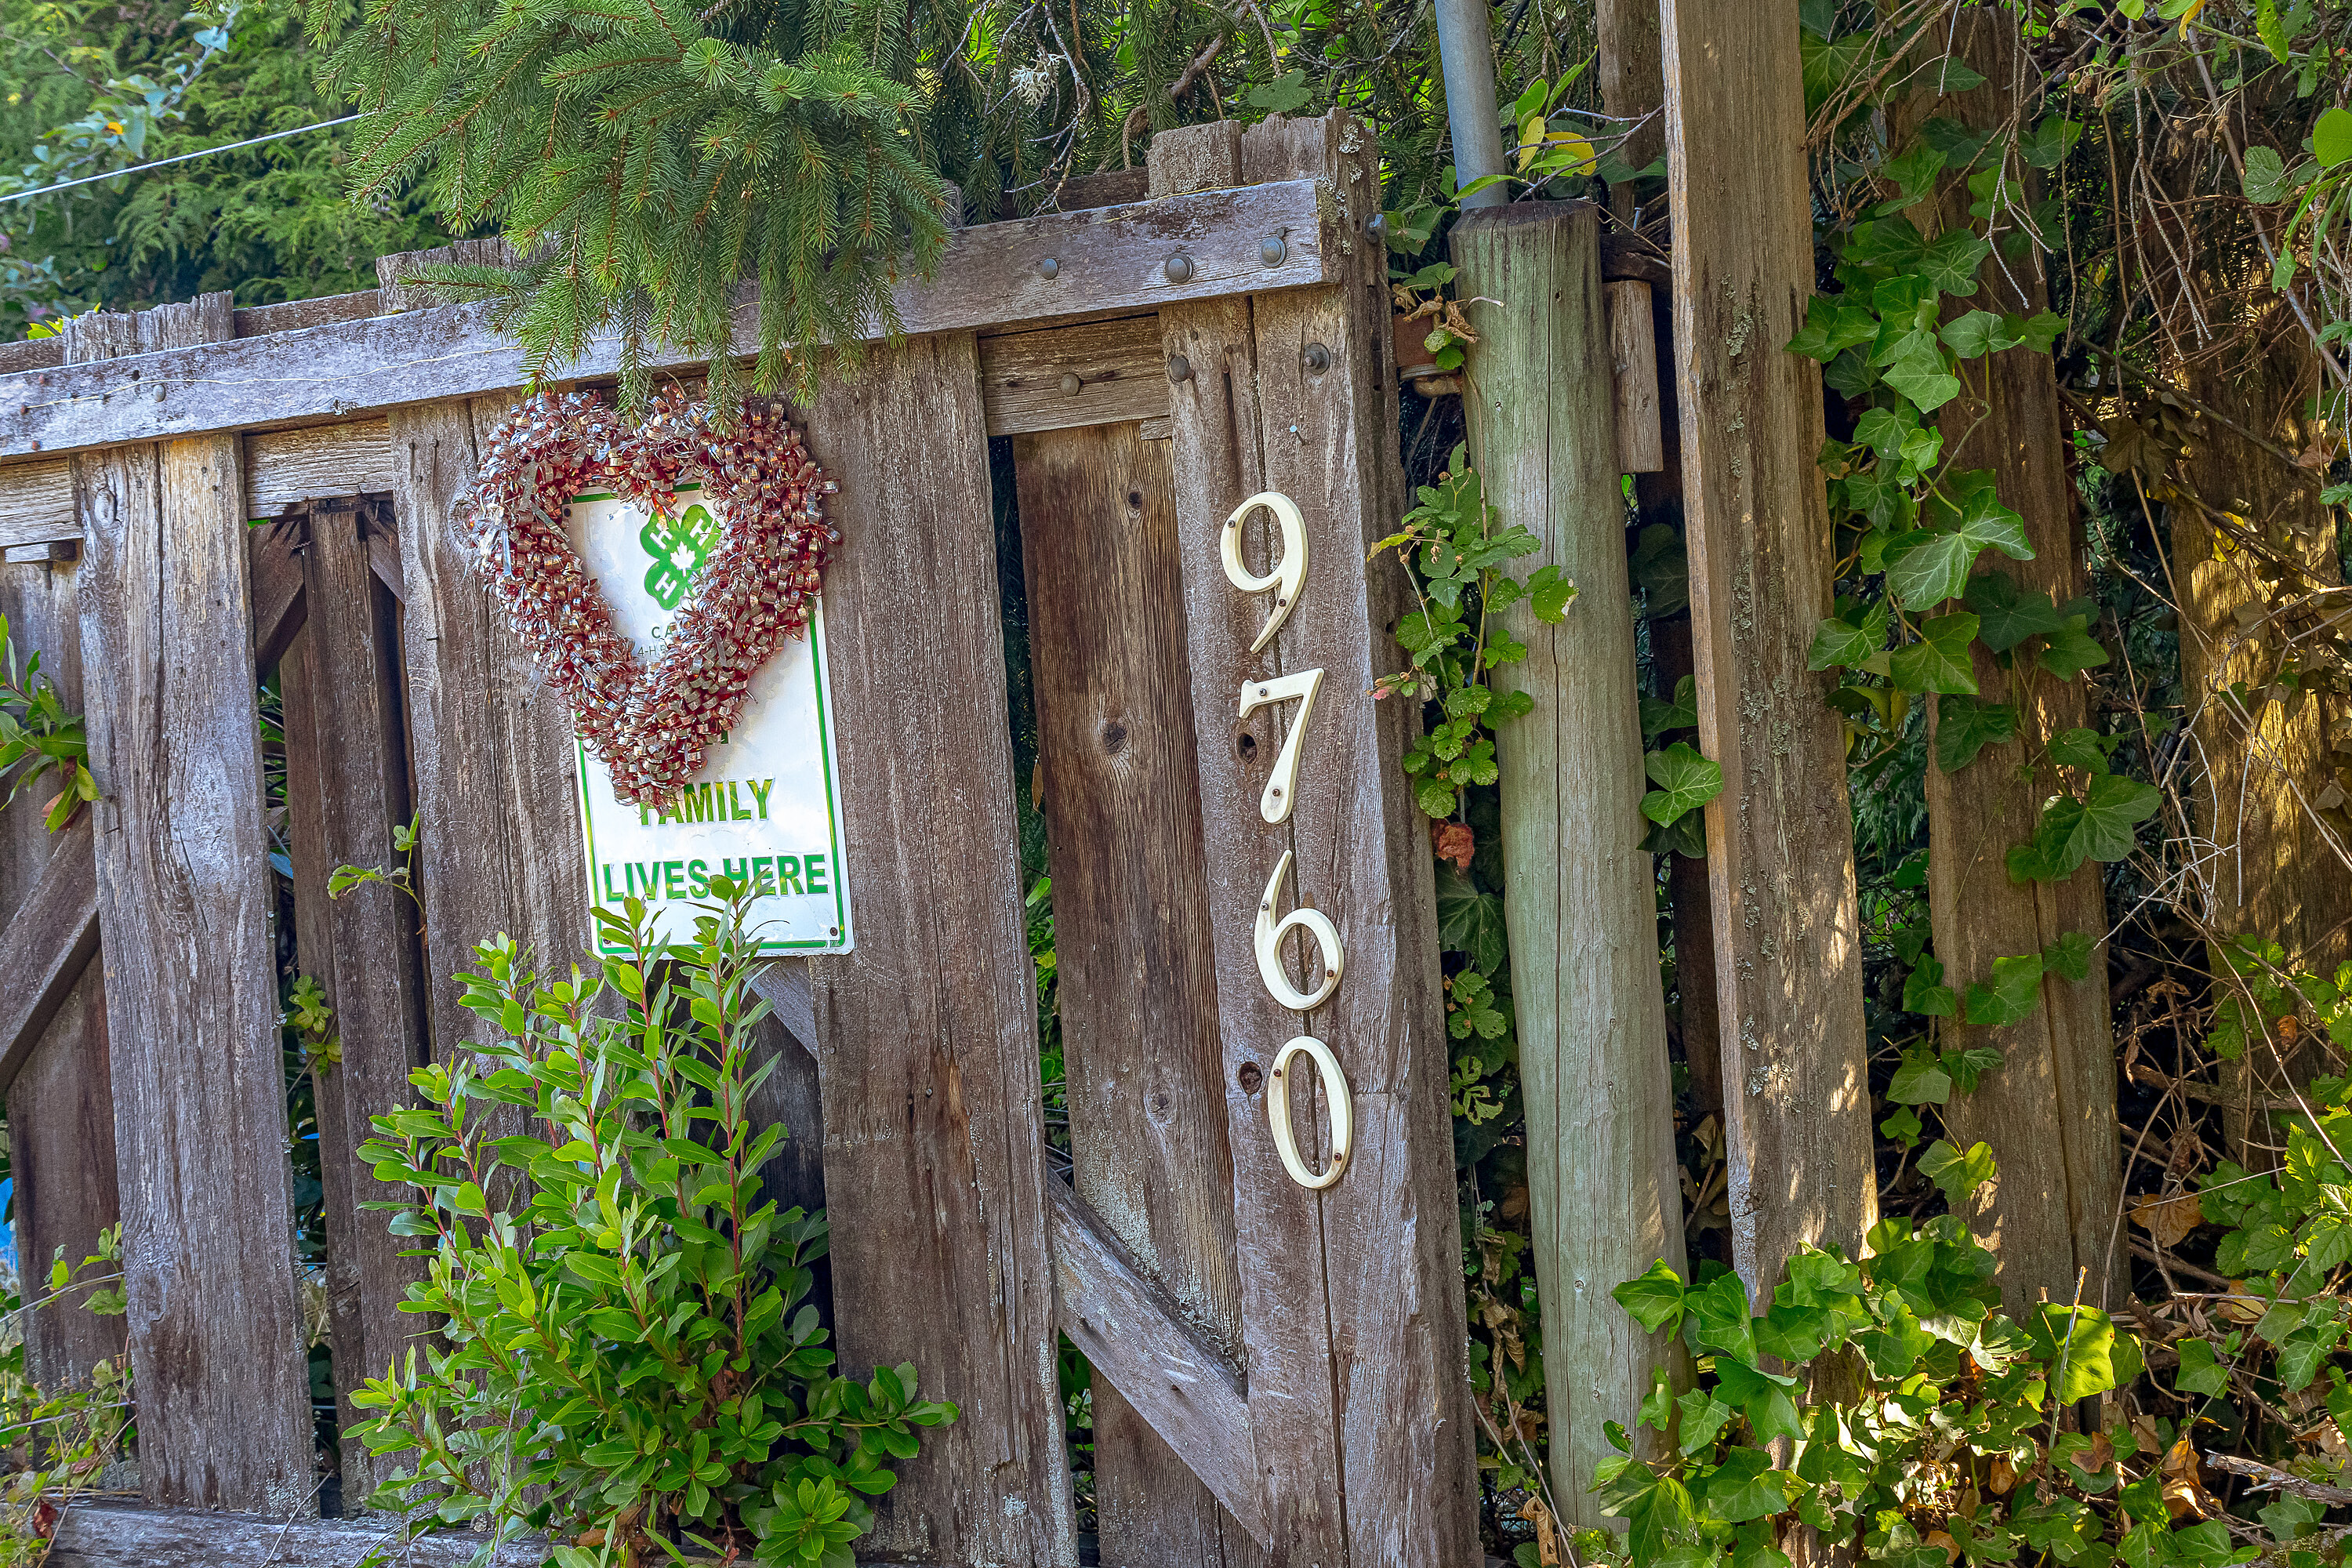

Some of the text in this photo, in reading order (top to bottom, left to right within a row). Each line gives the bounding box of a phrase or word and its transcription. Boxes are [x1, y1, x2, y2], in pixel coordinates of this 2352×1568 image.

[689, 517, 710, 547] H
[654, 571, 677, 601] H
[1220, 491, 1353, 1190] 9760
[603, 854, 829, 902] LIVES HERE
